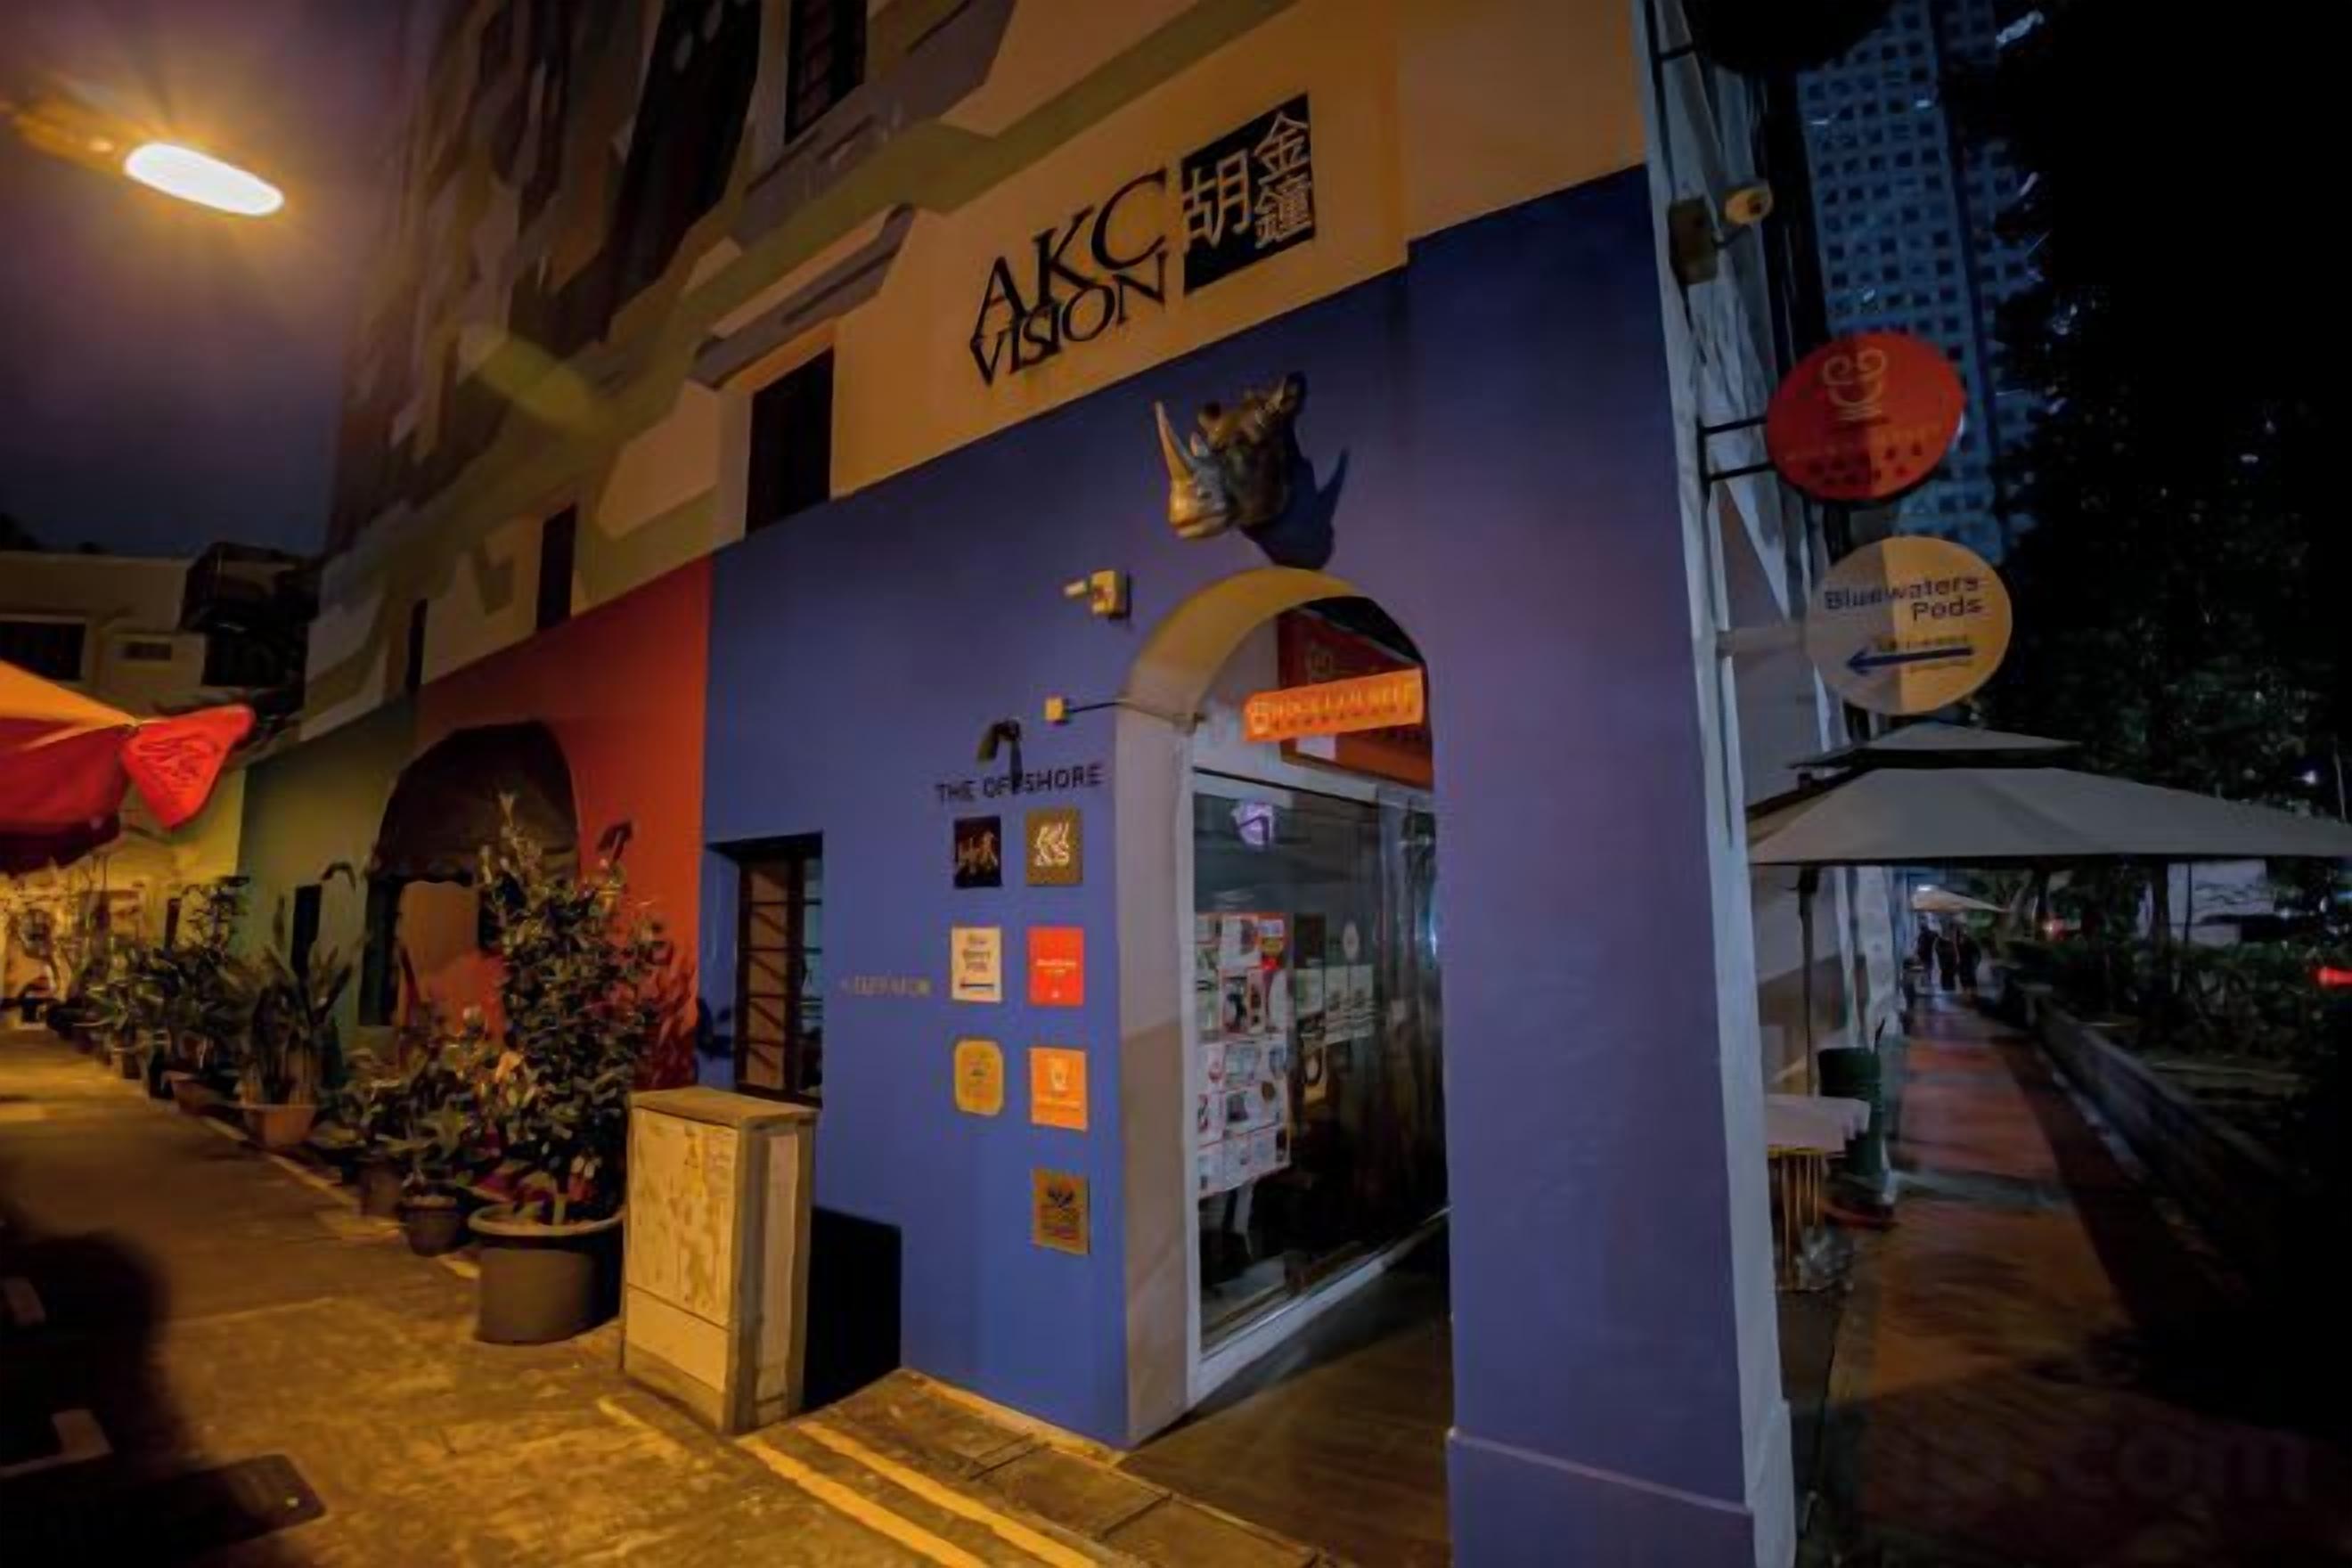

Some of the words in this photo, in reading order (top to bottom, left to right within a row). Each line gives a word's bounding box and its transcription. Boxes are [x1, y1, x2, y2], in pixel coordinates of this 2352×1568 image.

[973, 167, 1169, 326] AKC
[969, 249, 1169, 388] VISION
[1910, 596, 1984, 622] Pods
[935, 779, 976, 804] THE
